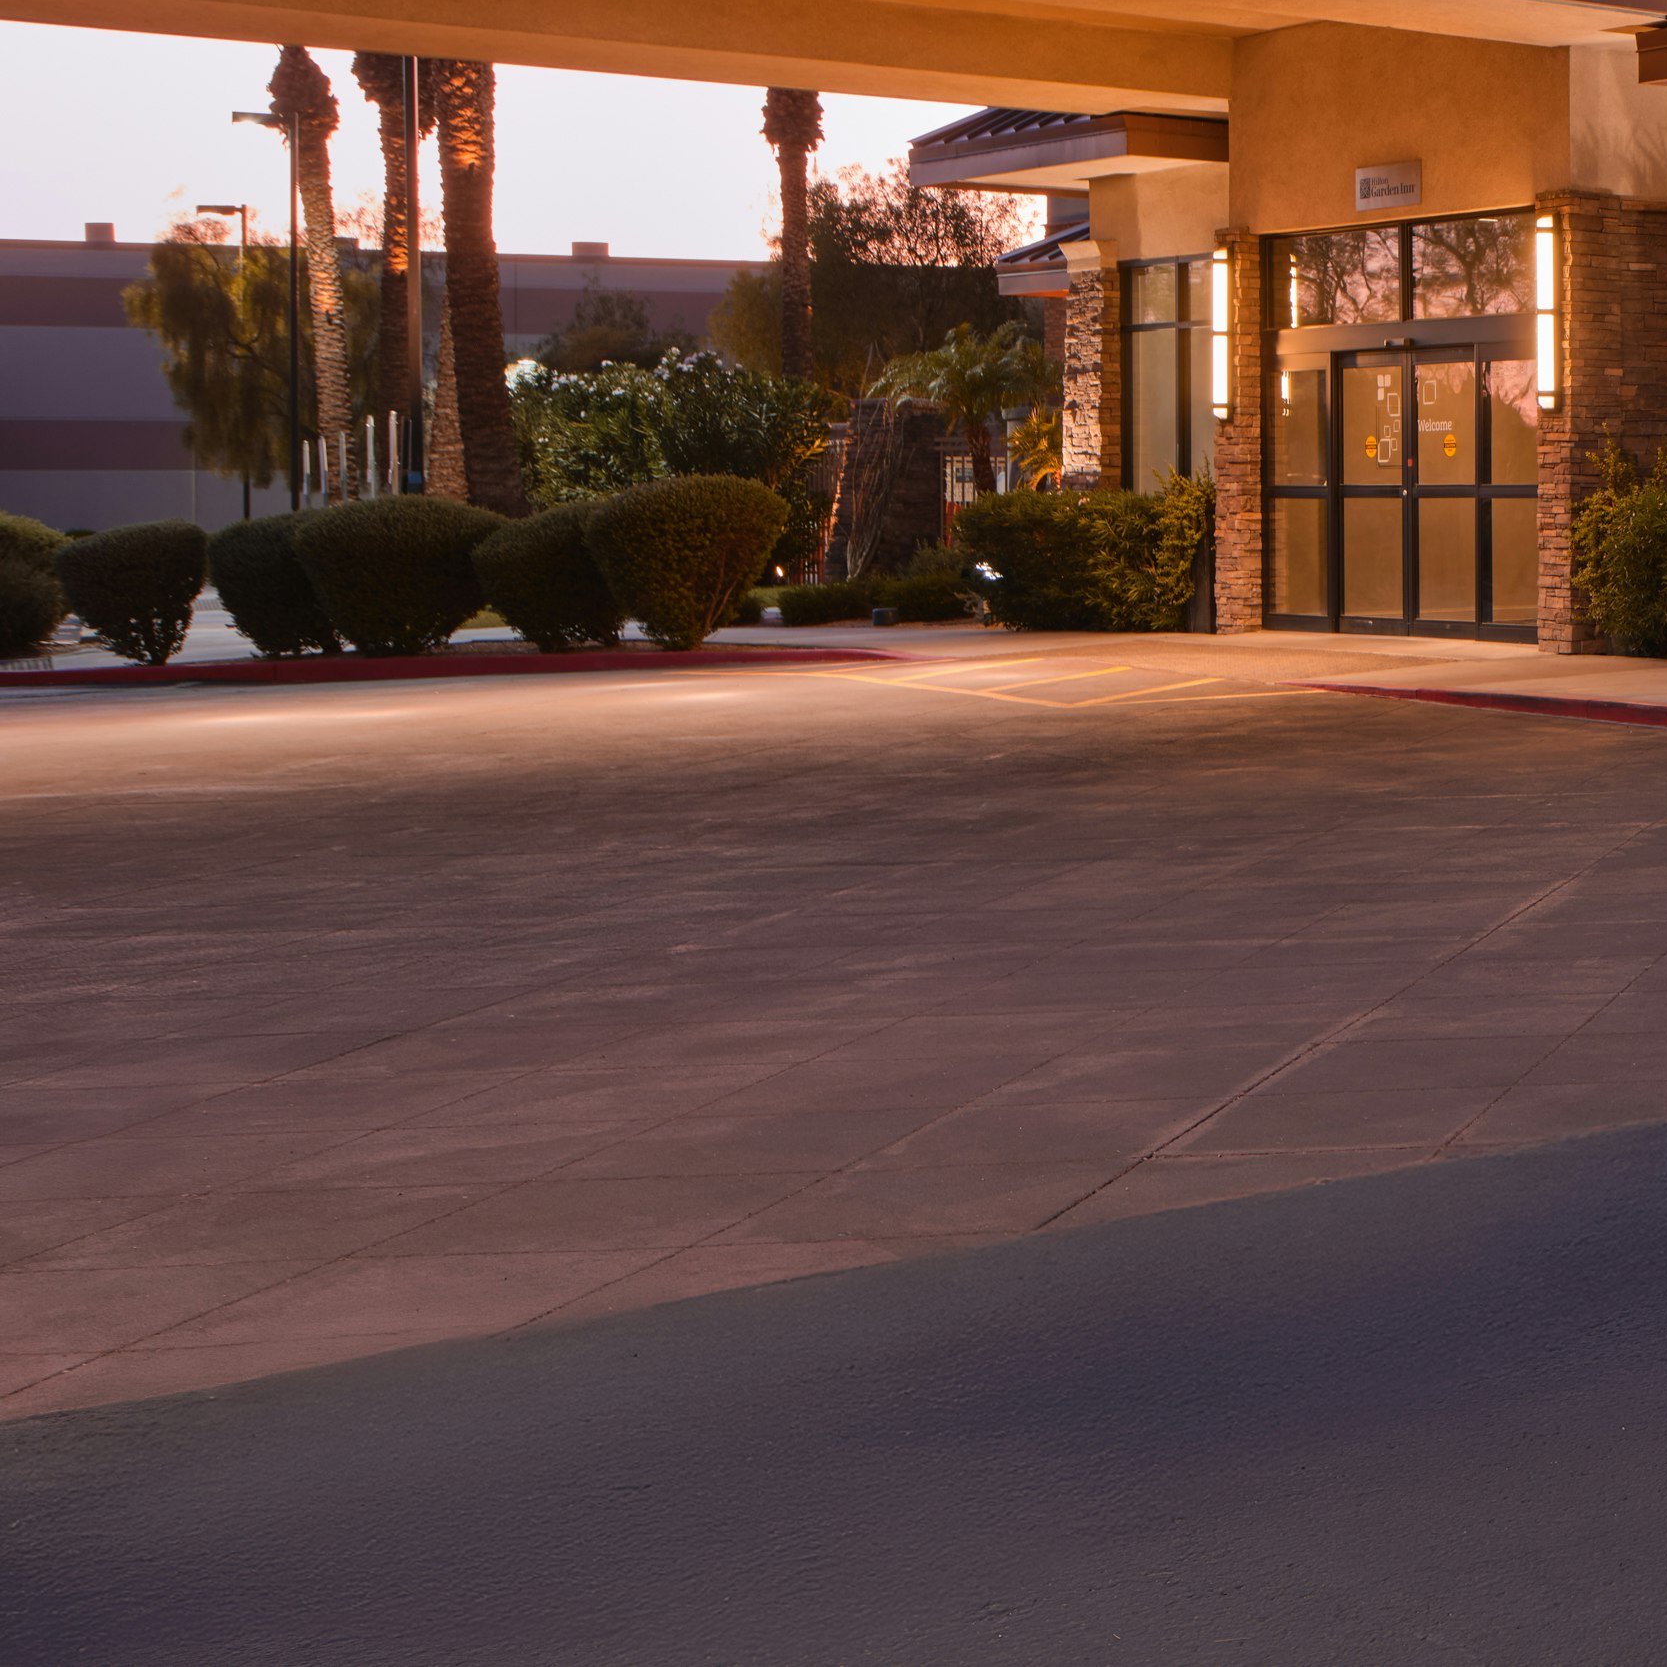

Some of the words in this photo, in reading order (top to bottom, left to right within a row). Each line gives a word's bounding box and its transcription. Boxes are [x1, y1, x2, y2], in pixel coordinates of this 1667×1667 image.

[1371, 177, 1389, 186] Hilton
[1371, 184, 1399, 198] Garden
[1400, 183, 1415, 194] Inn
[1417, 418, 1453, 432] Welcome
